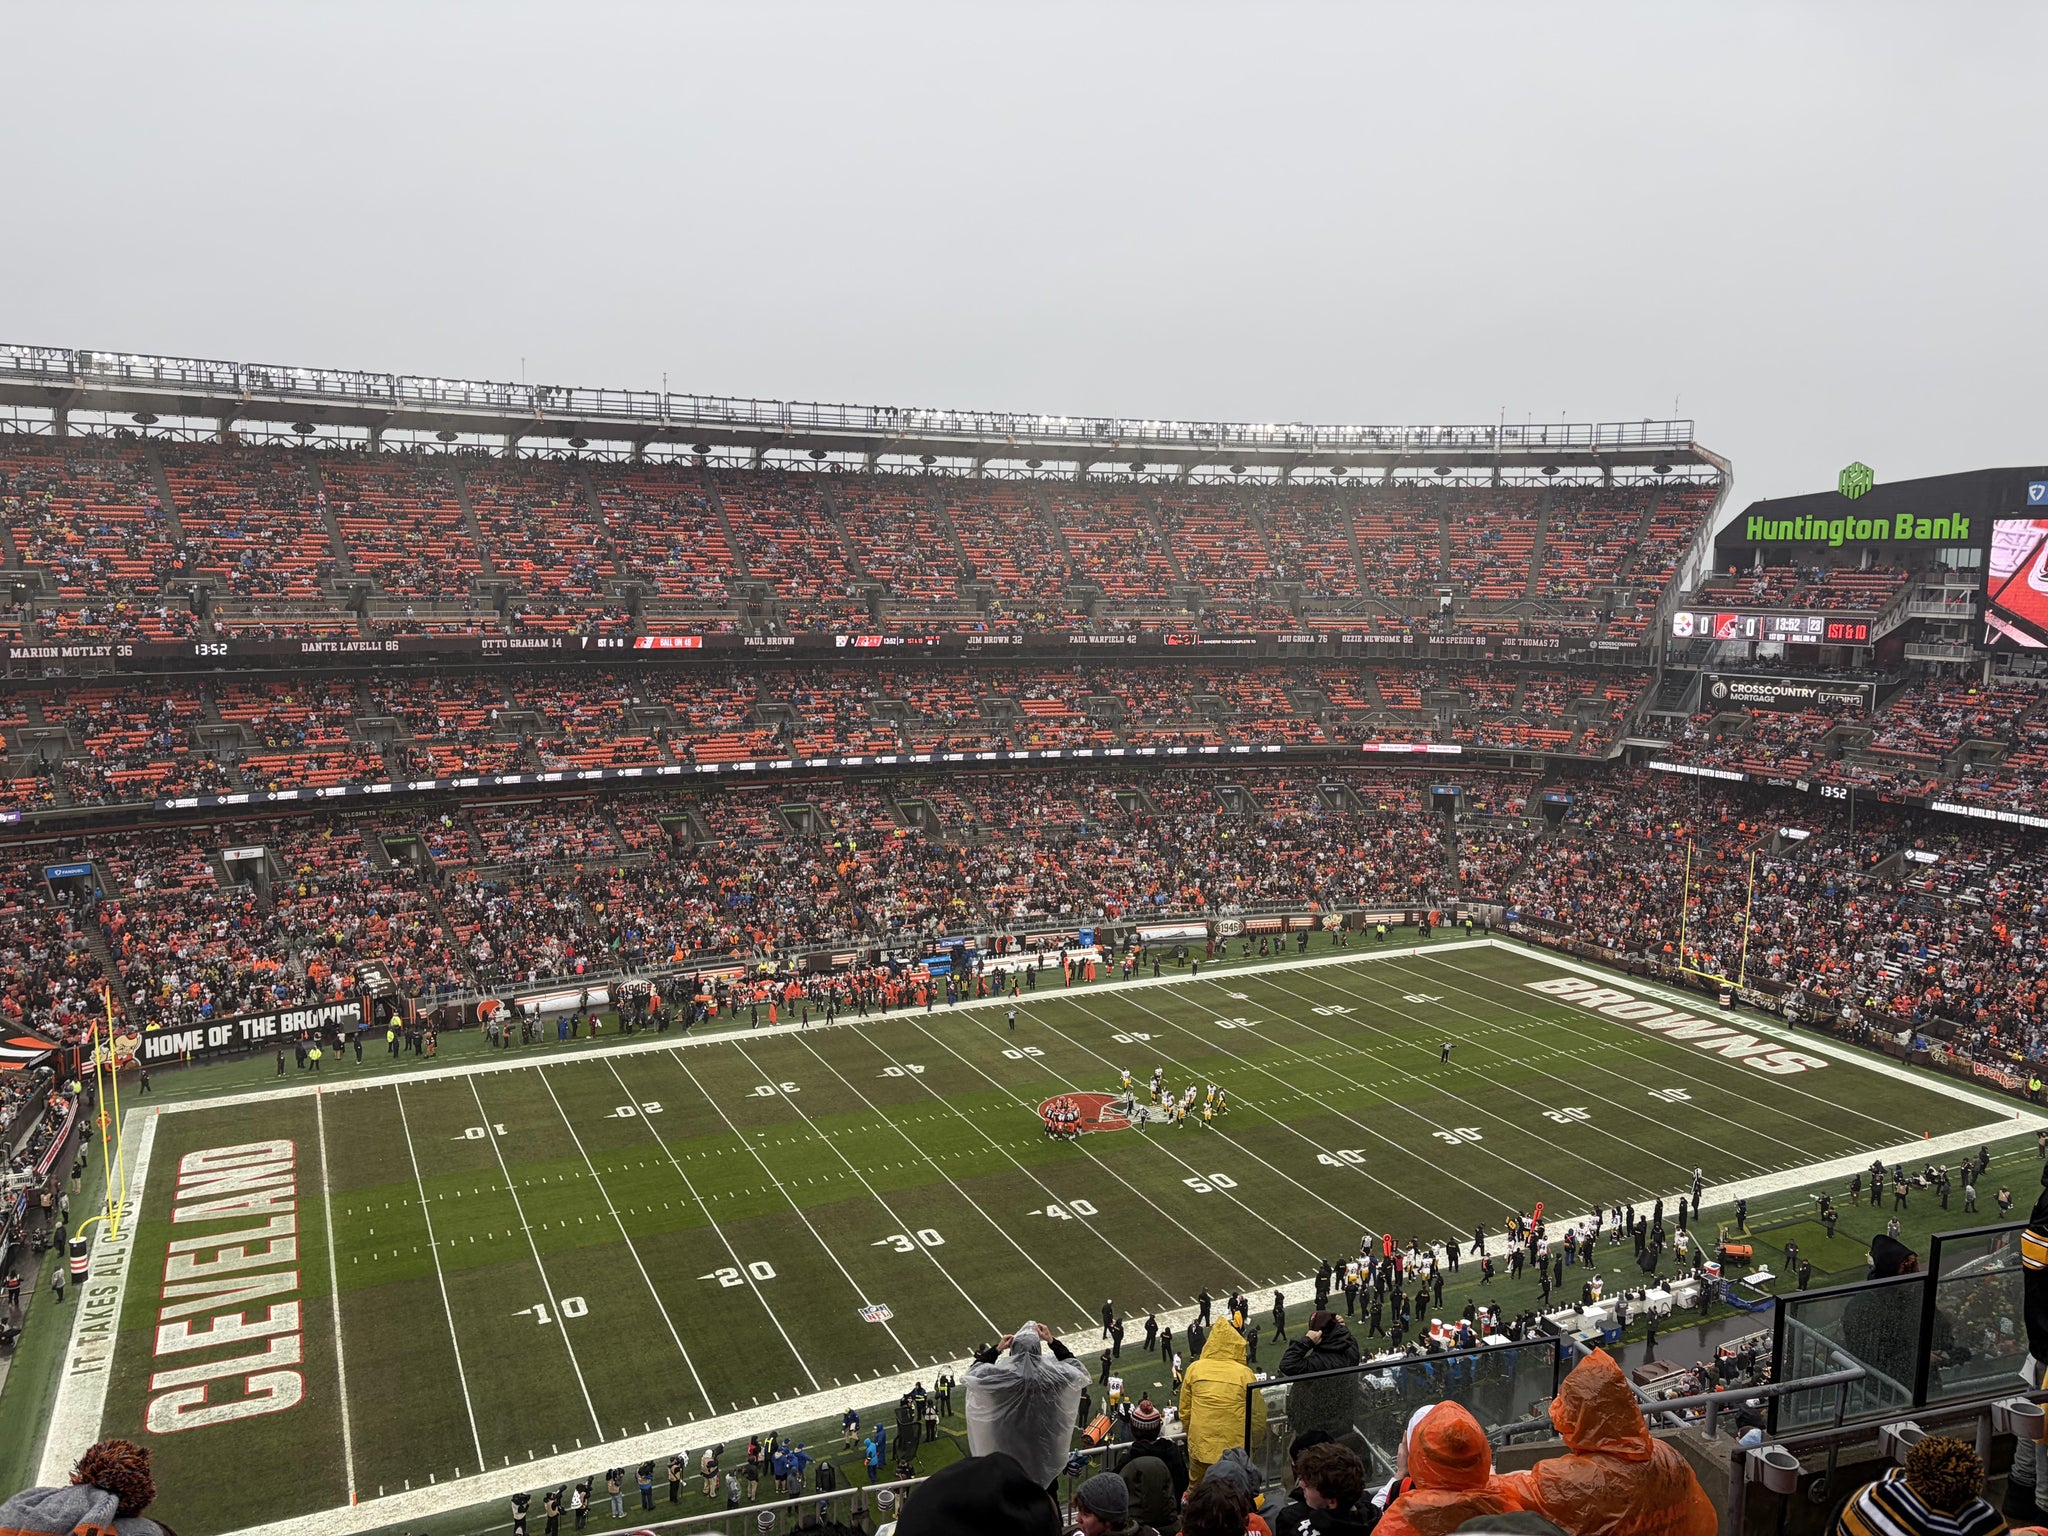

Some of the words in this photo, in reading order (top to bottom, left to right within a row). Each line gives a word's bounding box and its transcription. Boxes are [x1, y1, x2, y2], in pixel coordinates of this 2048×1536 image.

[1746, 515, 1890, 547] Huntington
[1894, 512, 1970, 540] Bank
[1700, 617, 1708, 634] 0
[1746, 618, 1754, 636] 0
[1776, 617, 1800, 631] 13:52
[1810, 620, 1820, 631] 23
[1828, 624, 1845, 638] 1ST
[1856, 625, 1866, 640] 10
[301, 642, 337, 652] DANTE
[340, 641, 382, 651] LAVELLI
[385, 640, 399, 651] 86
[482, 639, 507, 648] OTTO
[510, 639, 549, 648] GRAHAM
[551, 638, 562, 648] 14
[744, 637, 765, 645] PAUL
[767, 637, 795, 645] BROWN
[968, 636, 982, 644] JIM
[984, 636, 1009, 644] BROWN
[1012, 636, 1022, 644] 32
[1069, 636, 1087, 644] PAUL
[1089, 636, 1124, 644] WARFIELD
[1126, 635, 1137, 644] 42
[1278, 635, 1292, 643] LOU
[1293, 635, 1314, 643] GROZA
[1318, 635, 1328, 643] 76
[1342, 635, 1362, 643] OZZIE
[1364, 635, 1400, 643] NEWSOME
[1403, 635, 1413, 644] 82
[1429, 636, 1444, 644] MAC
[1446, 636, 1475, 645] SPEEDIE
[1476, 637, 1486, 645] 88
[1502, 638, 1517, 646] JOE
[1518, 639, 1548, 647] THOMAS
[1549, 639, 1559, 648] 73
[10, 647, 58, 658] MARION
[62, 646, 112, 657] MOTLEY
[117, 645, 133, 656] 36
[195, 643, 228, 655] 13:52
[1730, 683, 1816, 698] CROSSCOUNTRY
[1730, 693, 1775, 703] MORTGAGE
[1649, 761, 1676, 772] AMERICA
[1677, 765, 1698, 774] BUILDS
[1698, 768, 1714, 777] WITH
[1715, 770, 1744, 781] GREGORY
[1821, 786, 1847, 799] 13:52
[1932, 802, 1968, 815] AMERICA
[1968, 807, 1997, 819] BUILDS
[1997, 812, 2018, 823] WITH
[1221, 922, 1239, 933] 1946
[1648, 990, 1728, 1017] CHOOSE
[1730, 1017, 1792, 1037] LOVE
[145, 1028, 206, 1058] HOME
[209, 1022, 233, 1048] OF
[239, 1014, 277, 1040] THE
[281, 1002, 362, 1034] BROWNS
[1524, 976, 1830, 1074] BROWNS
[1647, 1088, 1692, 1102] 10
[1542, 1107, 1592, 1124] 20
[1432, 1127, 1484, 1145] 30
[1316, 1149, 1367, 1168] 40
[1182, 1172, 1238, 1194] 50
[1046, 1199, 1100, 1221] 40
[886, 1228, 946, 1254] 30
[94, 1248, 126, 1277] ALL
[715, 1260, 777, 1288] 20
[144, 1139, 306, 1436] CLEVELAND
[77, 1285, 118, 1348] TAKES
[532, 1296, 589, 1326] 10
[70, 1356, 106, 1376] IT
